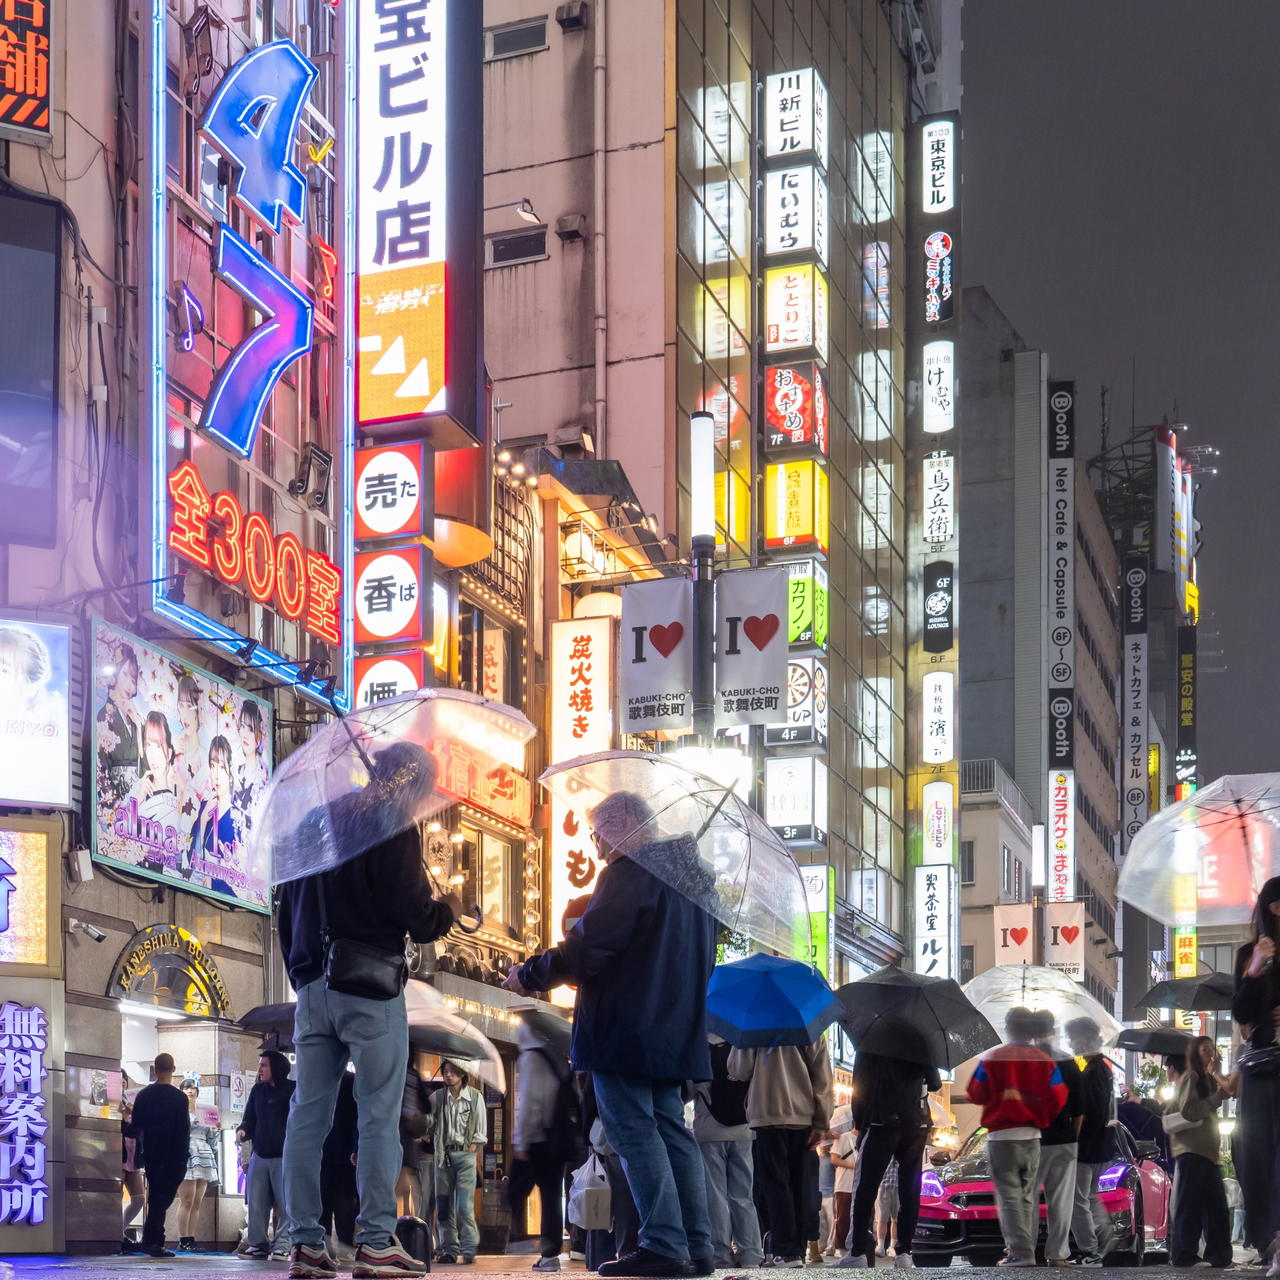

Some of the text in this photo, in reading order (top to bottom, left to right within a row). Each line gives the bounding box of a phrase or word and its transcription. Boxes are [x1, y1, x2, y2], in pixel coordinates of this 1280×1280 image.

[779, 74, 801, 152] 川新ビル
[931, 139, 946, 206] 東京ビル
[780, 173, 799, 248] にいむら
[771, 433, 784, 446] 7F
[1051, 390, 1073, 451] Booth
[168, 458, 344, 647] 全300室
[784, 535, 795, 546] 6F
[1053, 467, 1068, 621] Net Cafe & Capsule
[936, 578, 951, 588] 6F
[1126, 567, 1147, 624] Booth
[631, 626, 648, 664] I
[724, 614, 741, 655] I
[800, 632, 812, 641] 5F
[568, 634, 594, 739] 炭火焼き
[628, 692, 686, 706] KABUKI-CHO
[721, 687, 780, 699] KABUKI-CHO
[723, 697, 780, 713] 歌舞伎町
[628, 703, 686, 722] 歌舞伎町
[1051, 696, 1073, 758] Booth
[1130, 641, 1142, 780] ネットカフェ & カプセル
[781, 728, 798, 740] 4F
[114, 796, 178, 854] alma
[783, 827, 798, 839] 3F
[1054, 785, 1069, 902] カラオケ まねき
[922, 873, 943, 975] 喫茶室 ルノ
[1000, 928, 1010, 949] I
[1051, 925, 1060, 946] I
[121, 932, 181, 992] KANESHIMA
[1178, 937, 1194, 965] 麻雀
